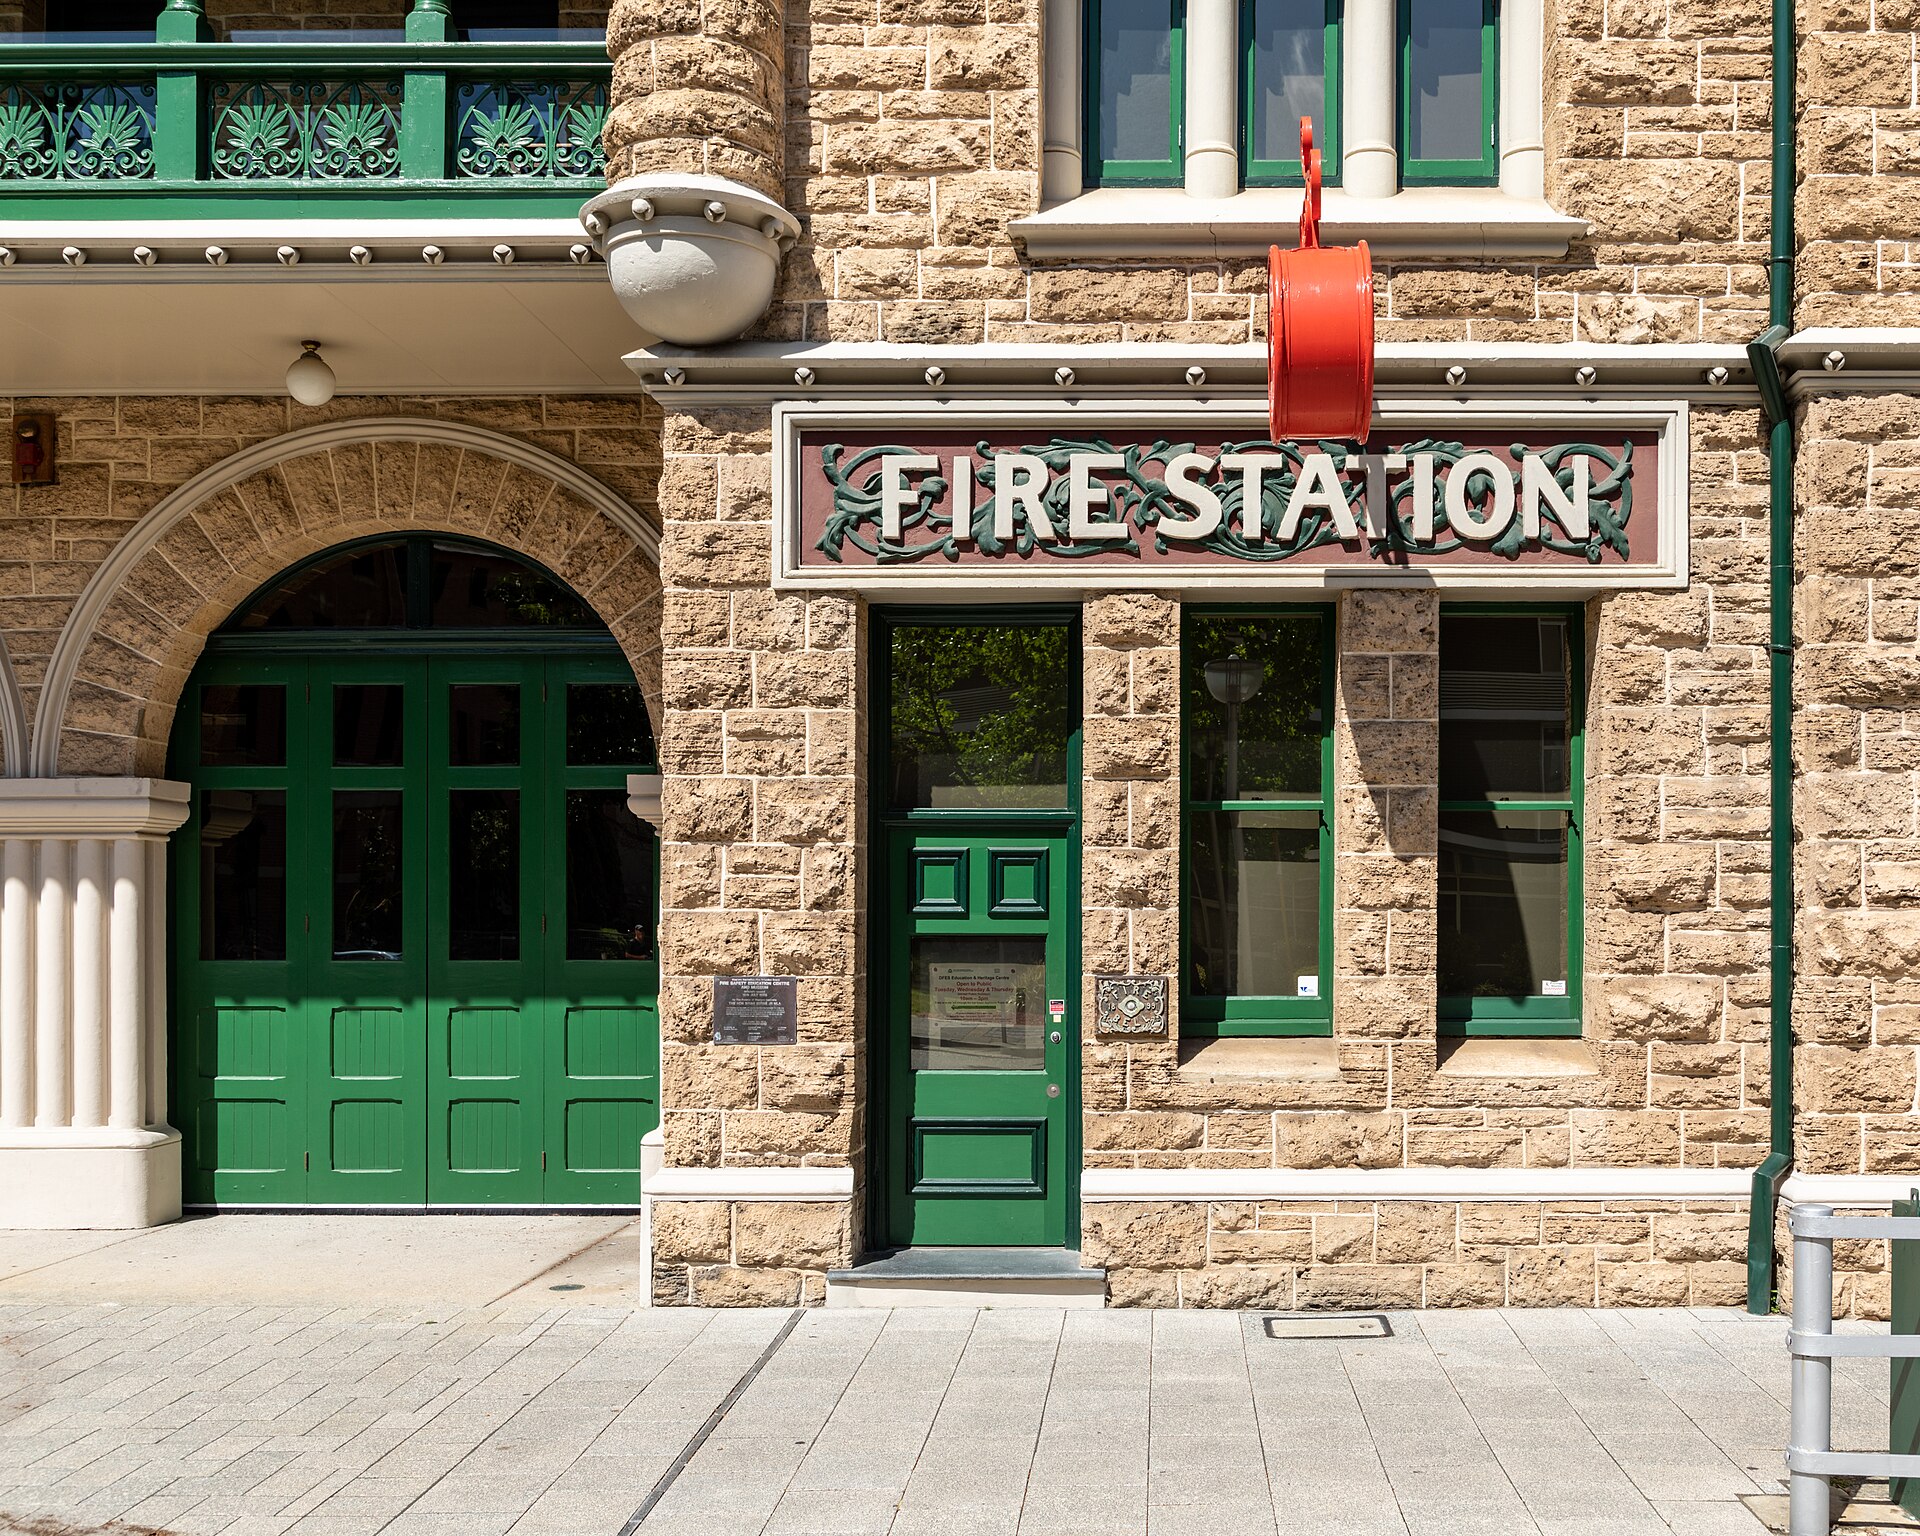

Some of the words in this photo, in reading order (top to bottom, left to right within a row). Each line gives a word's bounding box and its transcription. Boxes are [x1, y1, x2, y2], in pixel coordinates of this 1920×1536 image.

[882, 454, 1128, 540] FIRE
[1156, 452, 1590, 541] STATION
[1112, 986, 1152, 1000] FIRE
[1113, 1014, 1151, 1028] BELL
